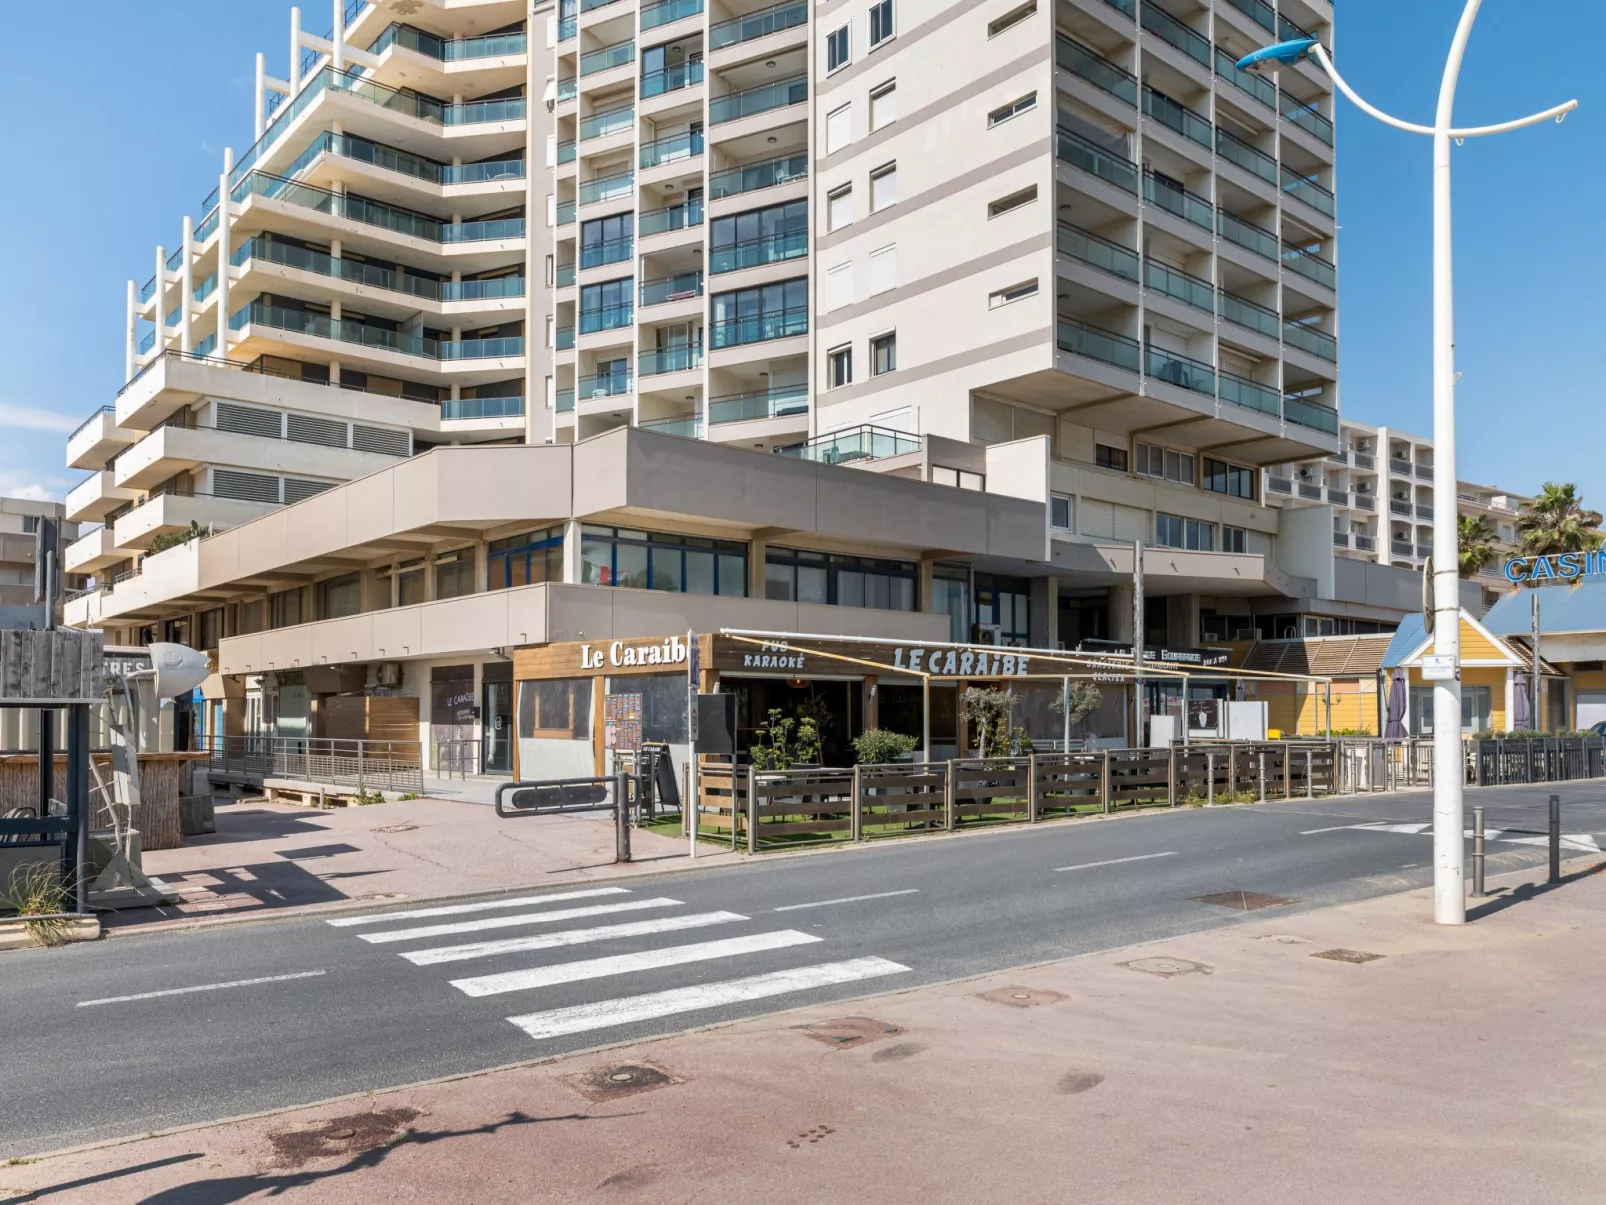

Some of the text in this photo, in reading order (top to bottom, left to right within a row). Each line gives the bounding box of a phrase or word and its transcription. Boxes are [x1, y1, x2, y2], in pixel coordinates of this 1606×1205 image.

[761, 640, 788, 652] PUB
[581, 644, 604, 669] Le
[743, 652, 805, 668] KARAOKÉ
[893, 648, 925, 672] LE
